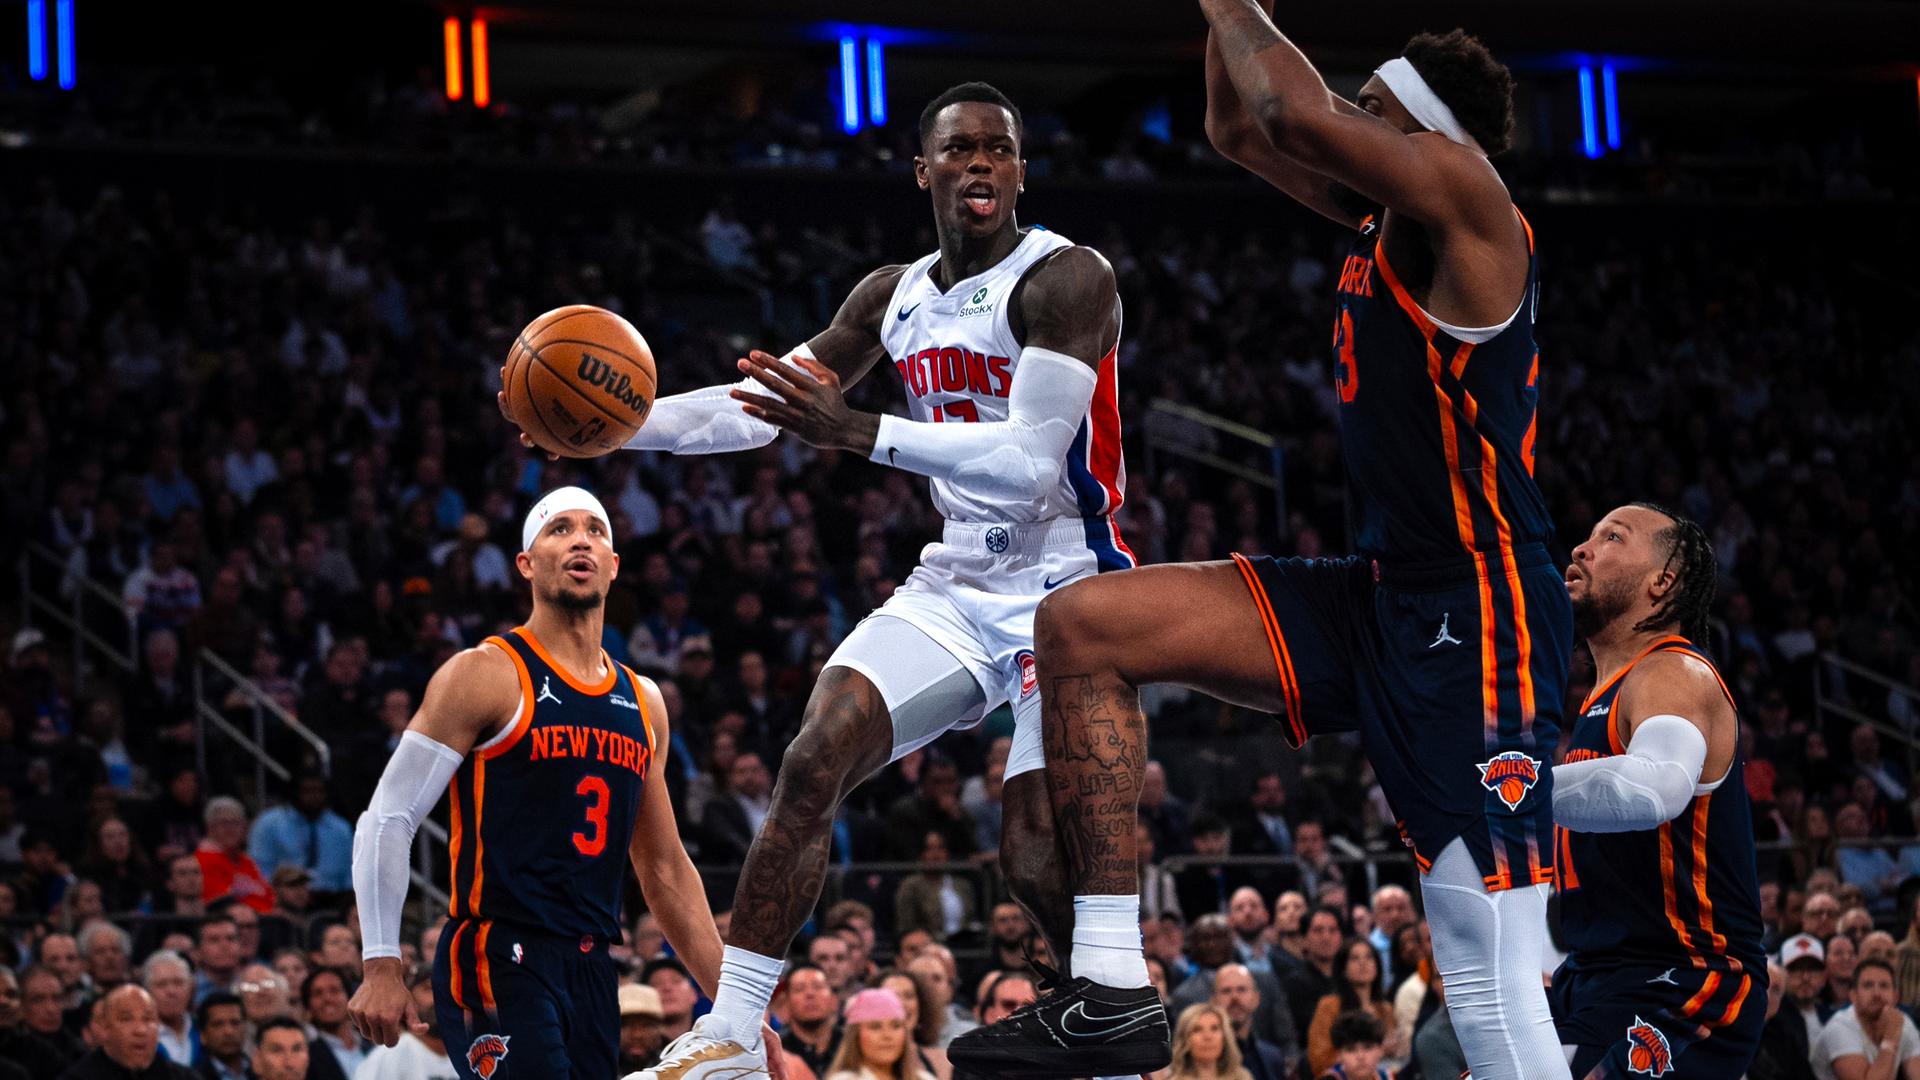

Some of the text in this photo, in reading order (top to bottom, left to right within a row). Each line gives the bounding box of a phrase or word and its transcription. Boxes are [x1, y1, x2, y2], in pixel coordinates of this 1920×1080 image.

[960, 304, 993, 317] StockX
[1332, 304, 1359, 403] 3
[577, 353, 650, 419] Wilson
[530, 725, 649, 781] NEW YORK
[1485, 759, 1537, 782] KNICKS
[572, 775, 610, 858] 3
[1630, 1026, 1669, 1075] KNICKS
